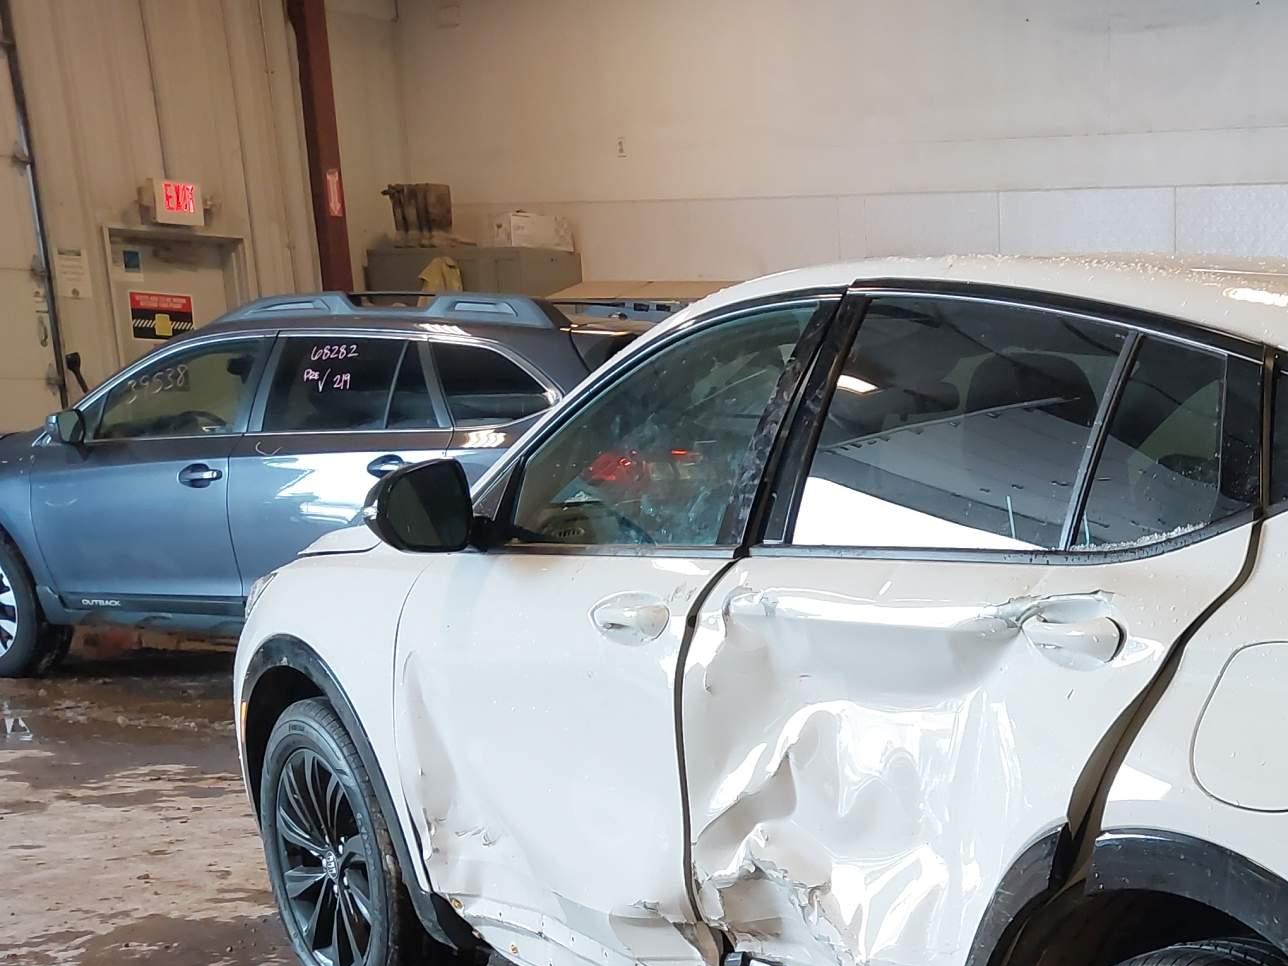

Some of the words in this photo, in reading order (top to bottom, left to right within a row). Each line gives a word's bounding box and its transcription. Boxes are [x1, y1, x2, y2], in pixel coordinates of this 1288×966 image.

[162, 182, 194, 212] EXIT
[310, 344, 360, 361] 68282
[81, 599, 121, 607] OUTBACK
